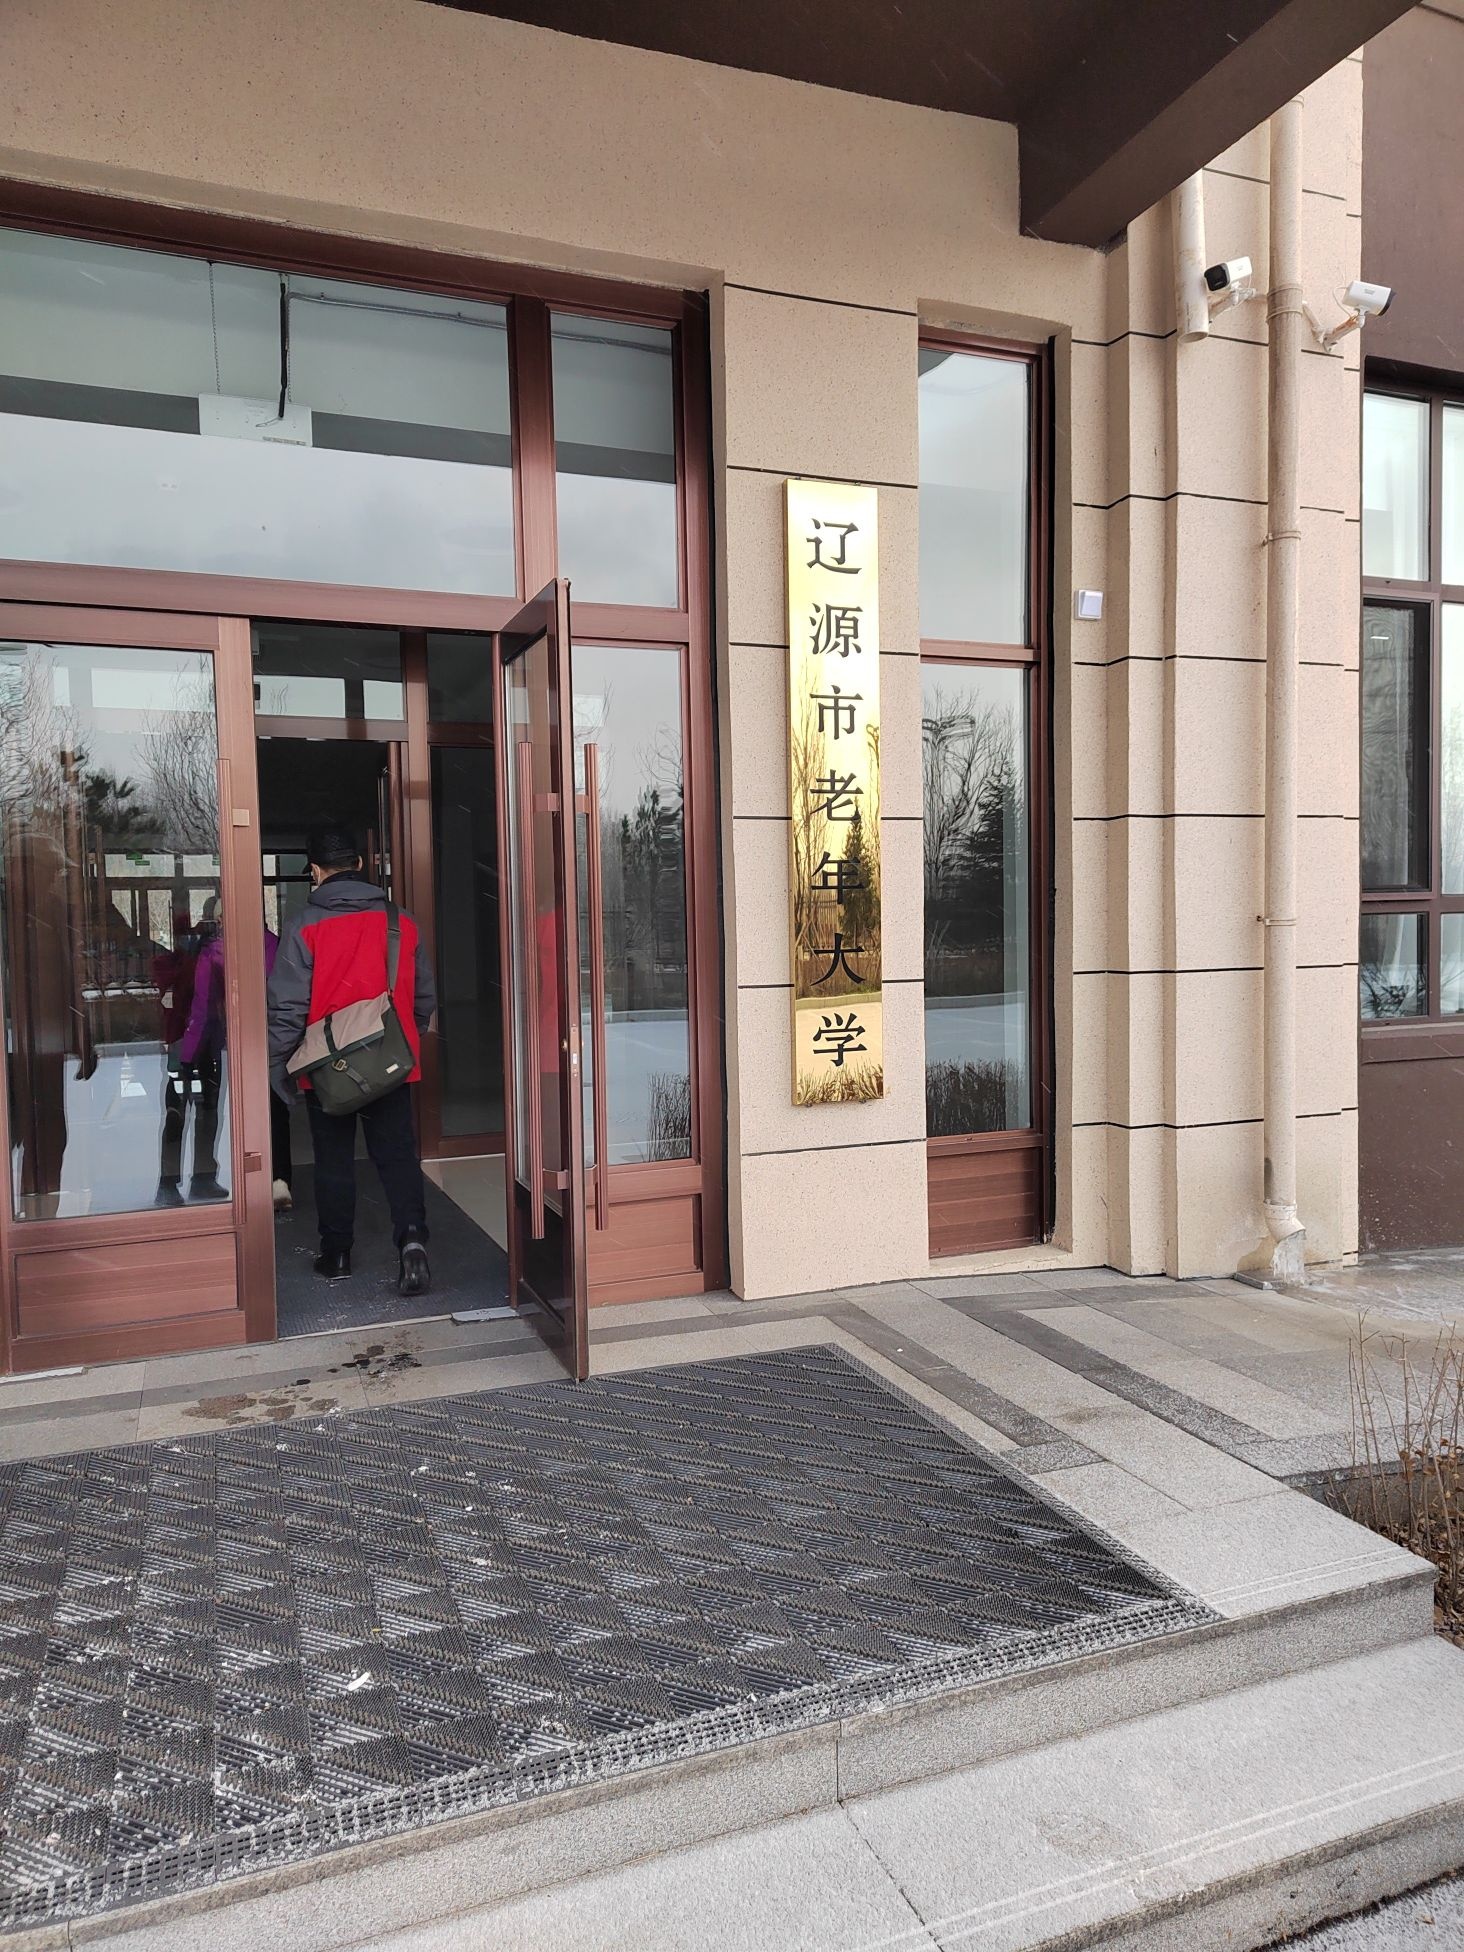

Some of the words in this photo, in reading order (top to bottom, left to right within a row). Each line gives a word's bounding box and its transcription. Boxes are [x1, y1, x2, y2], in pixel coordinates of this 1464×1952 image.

[806, 518, 868, 1067] 辽源市老年大学
